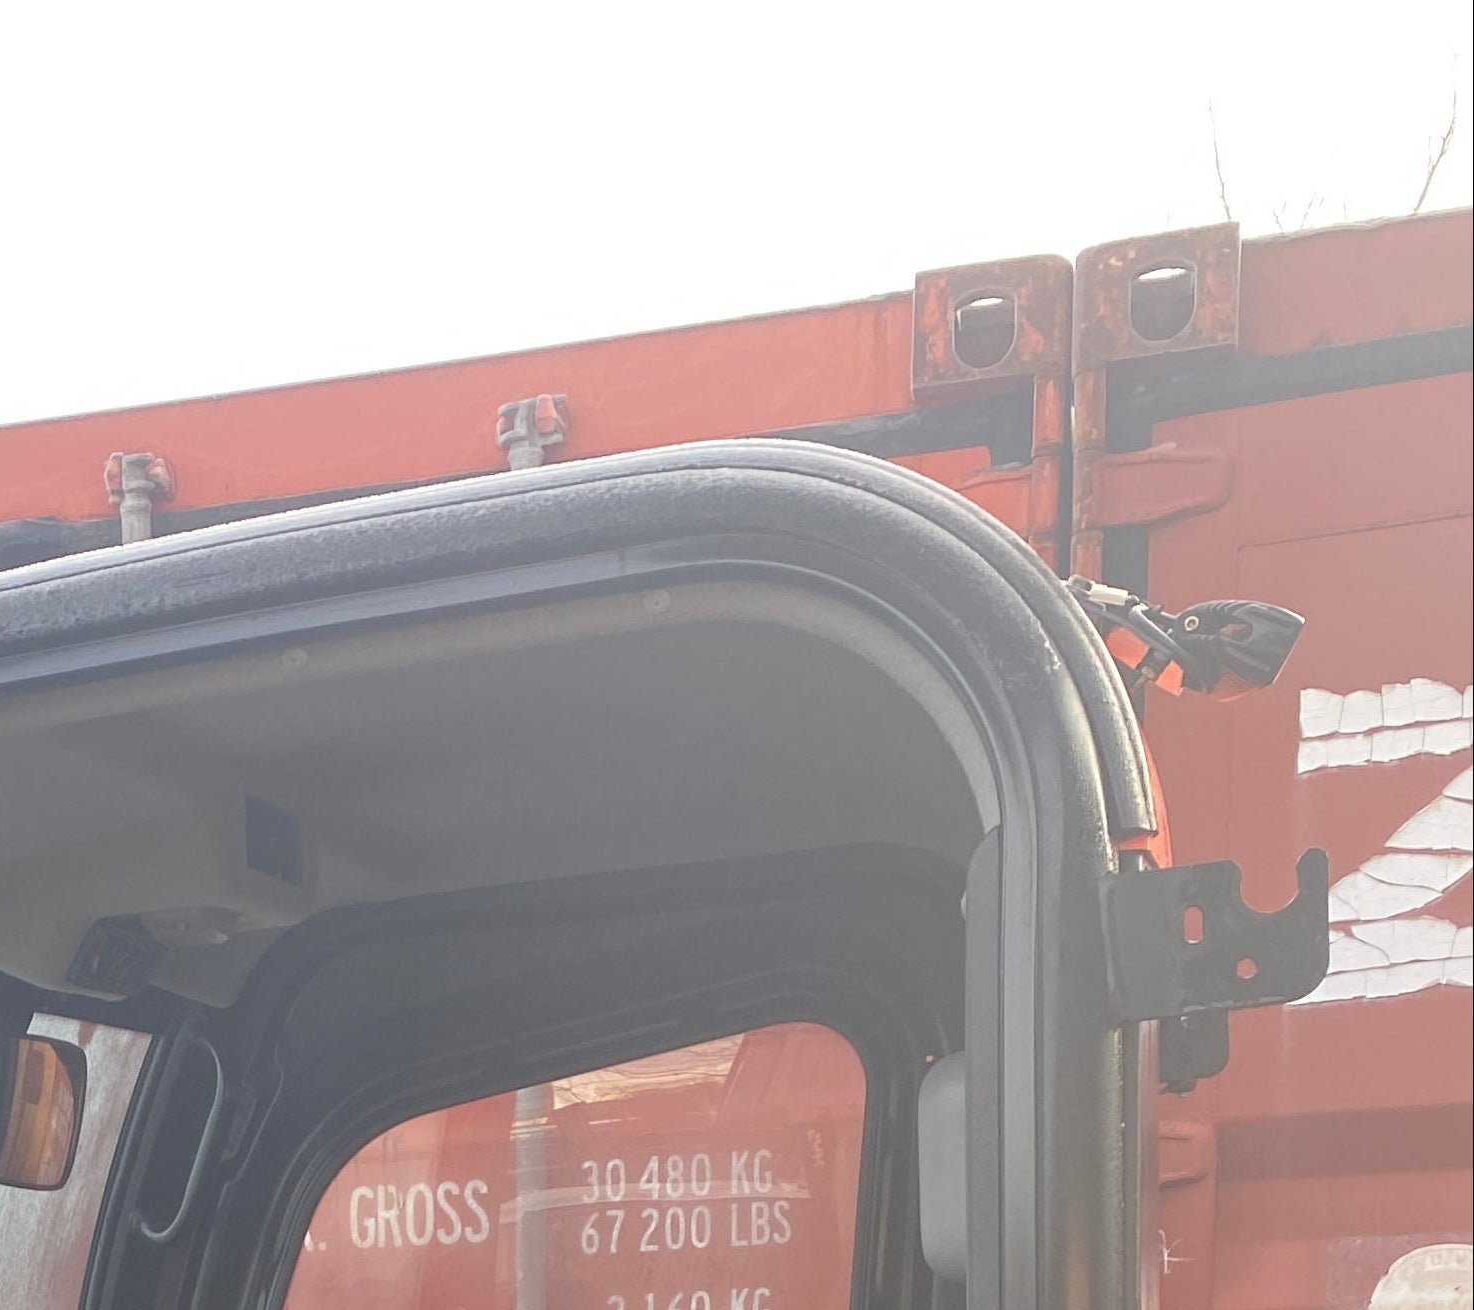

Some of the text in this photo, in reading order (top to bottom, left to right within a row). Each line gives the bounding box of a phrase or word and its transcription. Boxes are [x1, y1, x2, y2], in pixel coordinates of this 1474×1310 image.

[581, 1149, 772, 1203] 30 480 KG
[349, 1179, 490, 1249] GROSS
[581, 1200, 791, 1255] 67 200 LBS
